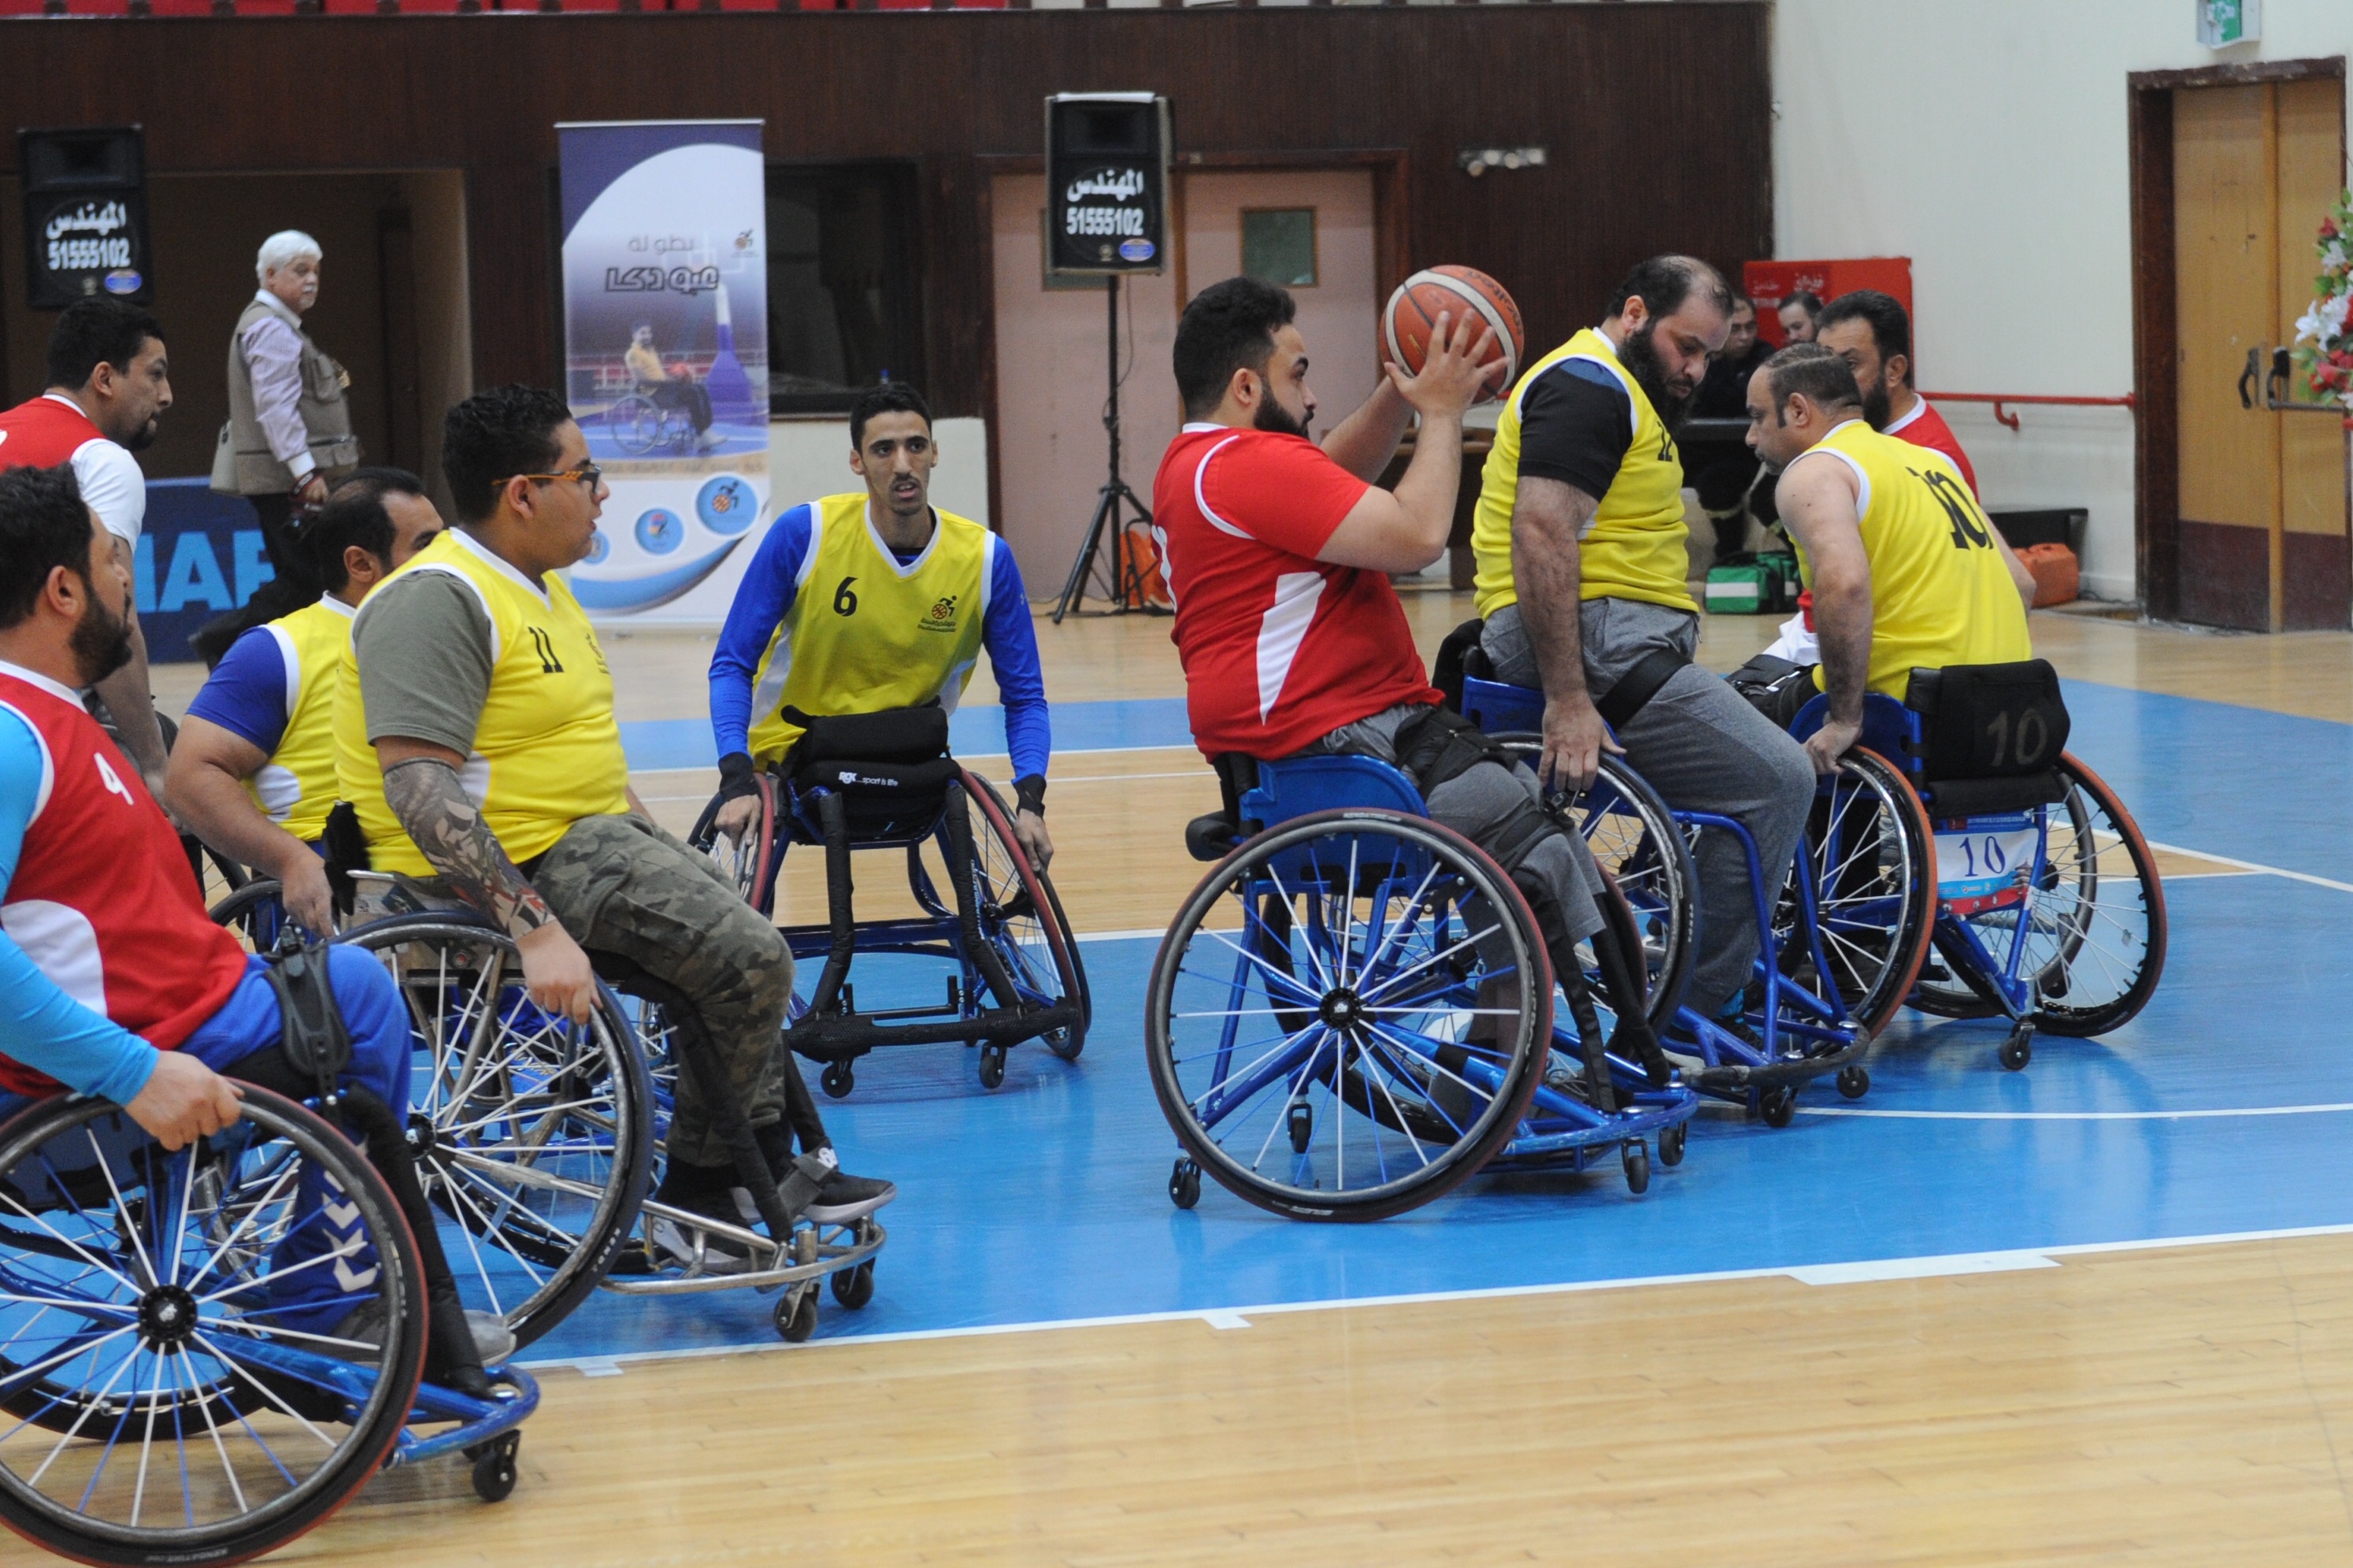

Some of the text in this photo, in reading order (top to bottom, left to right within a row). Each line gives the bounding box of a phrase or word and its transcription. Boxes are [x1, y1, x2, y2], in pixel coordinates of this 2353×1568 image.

[1067, 169, 1144, 202] المهندس
[46, 201, 127, 239] المهندس
[1066, 206, 1144, 236] 51555102
[48, 237, 132, 270] 51555102
[1905, 466, 1994, 550] 10
[833, 576, 858, 617] 6
[528, 626, 565, 674] 11
[1987, 709, 2047, 767] 10
[94, 752, 134, 806] 4
[1959, 836, 2006, 877] 10
